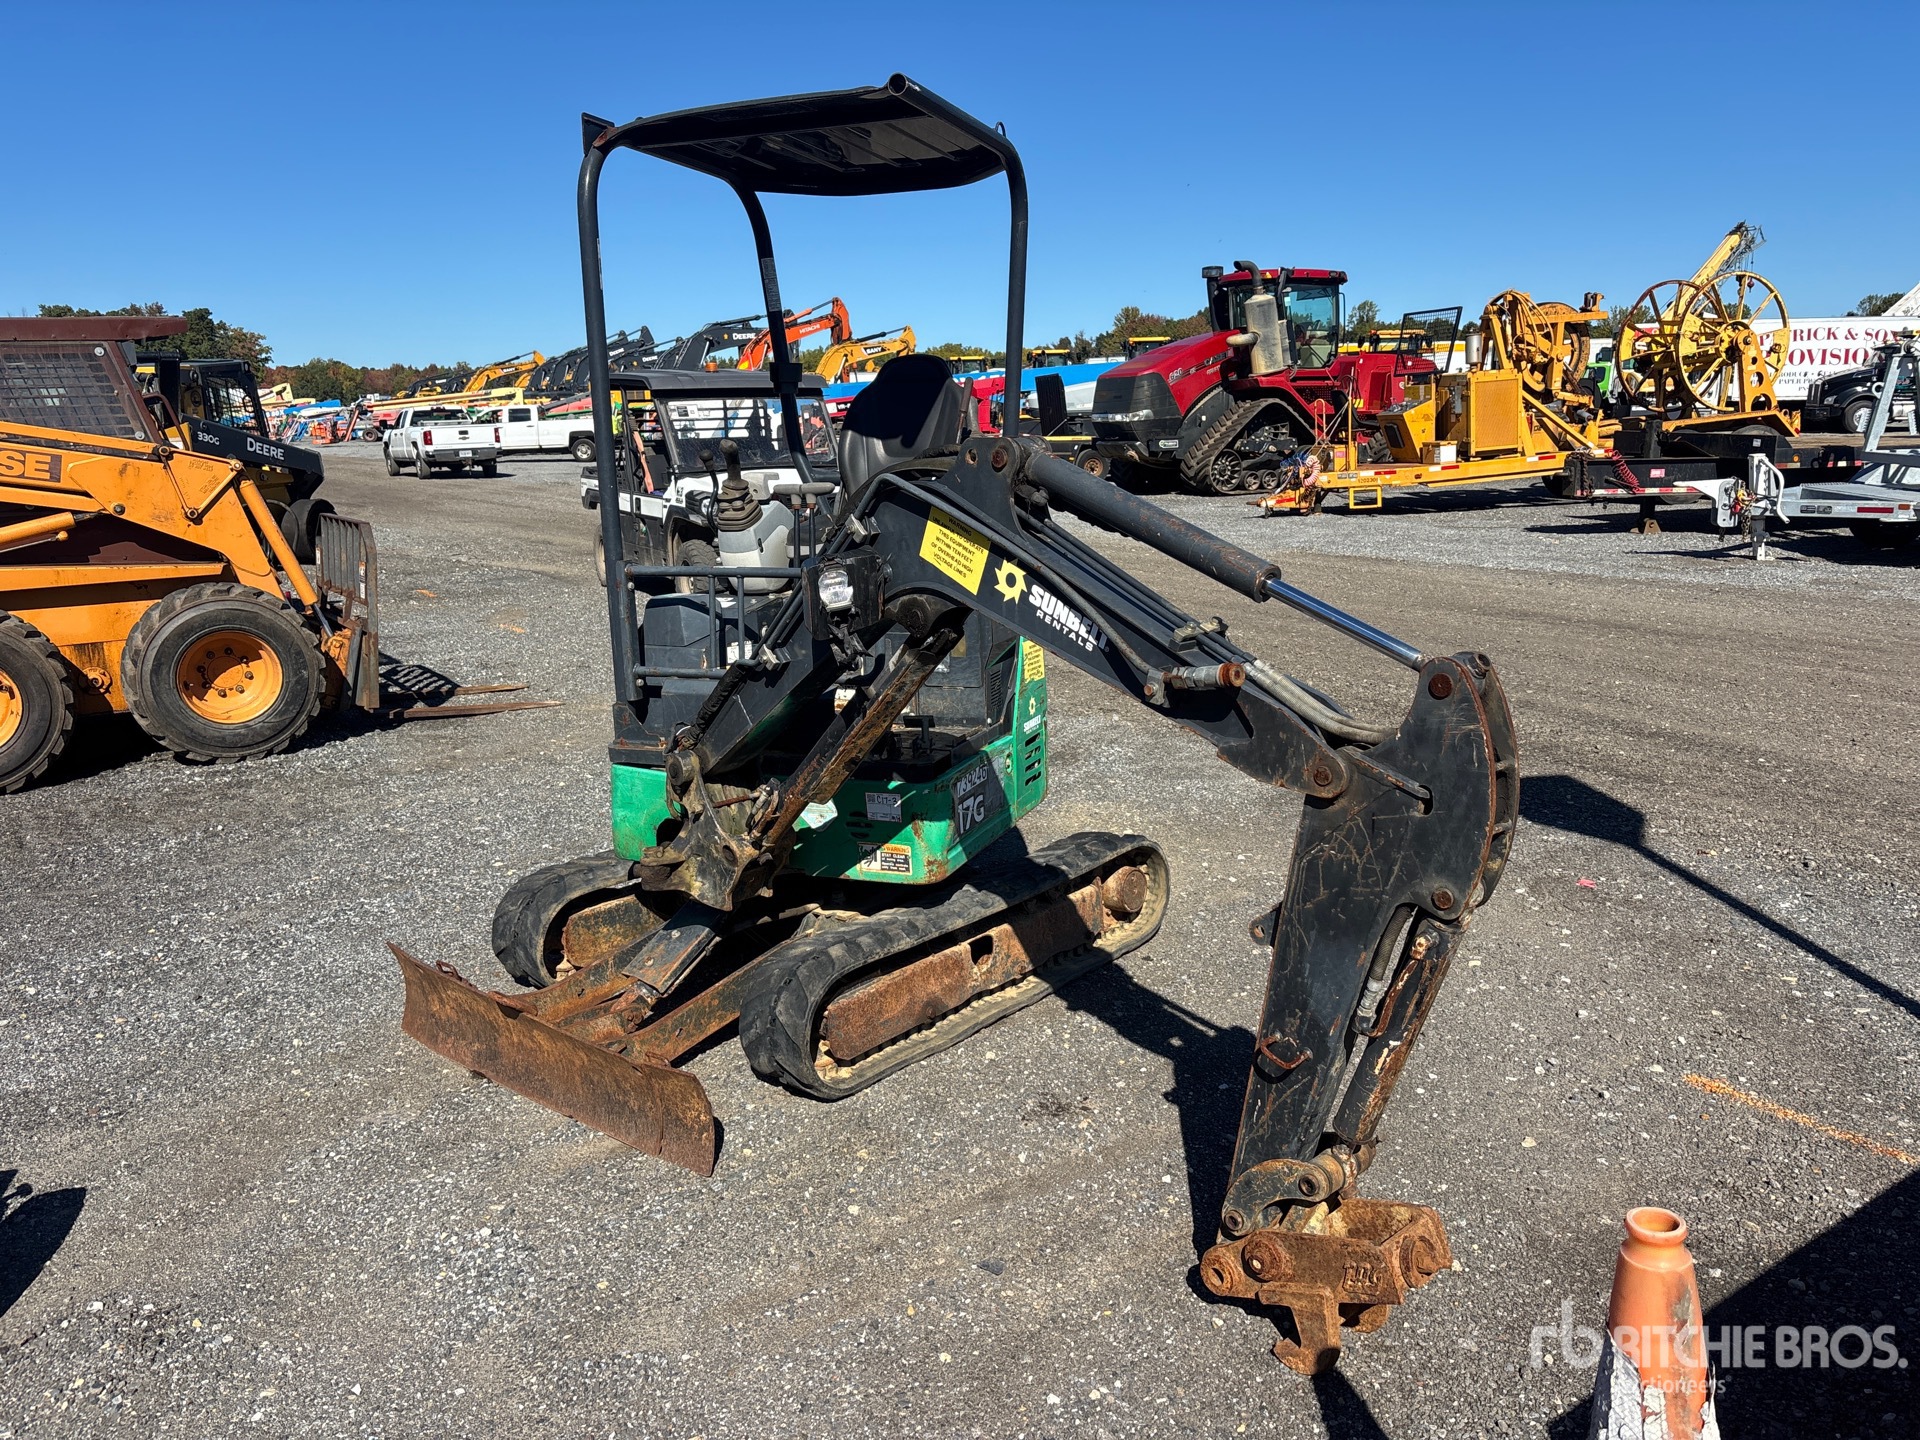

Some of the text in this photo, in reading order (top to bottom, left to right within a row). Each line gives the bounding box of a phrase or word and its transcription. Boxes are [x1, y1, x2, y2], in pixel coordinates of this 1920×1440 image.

[799, 324, 820, 334] HITACHI
[1845, 327, 1859, 341] &
[866, 347, 882, 355] SANY
[197, 431, 220, 446] 330G
[246, 437, 285, 460] DEERE
[948, 516, 972, 537] WARNING
[935, 535, 974, 564] WITHIN TEN FEET
[938, 528, 976, 557] THIS EQUIPMENT
[930, 541, 974, 575] OF OVERHEAD HIGH
[933, 551, 967, 578] VOLTAGE LINES
[1028, 584, 1108, 650] SUNBELT
[1036, 609, 1094, 652] RENTALS
[957, 794, 985, 835] 17G
